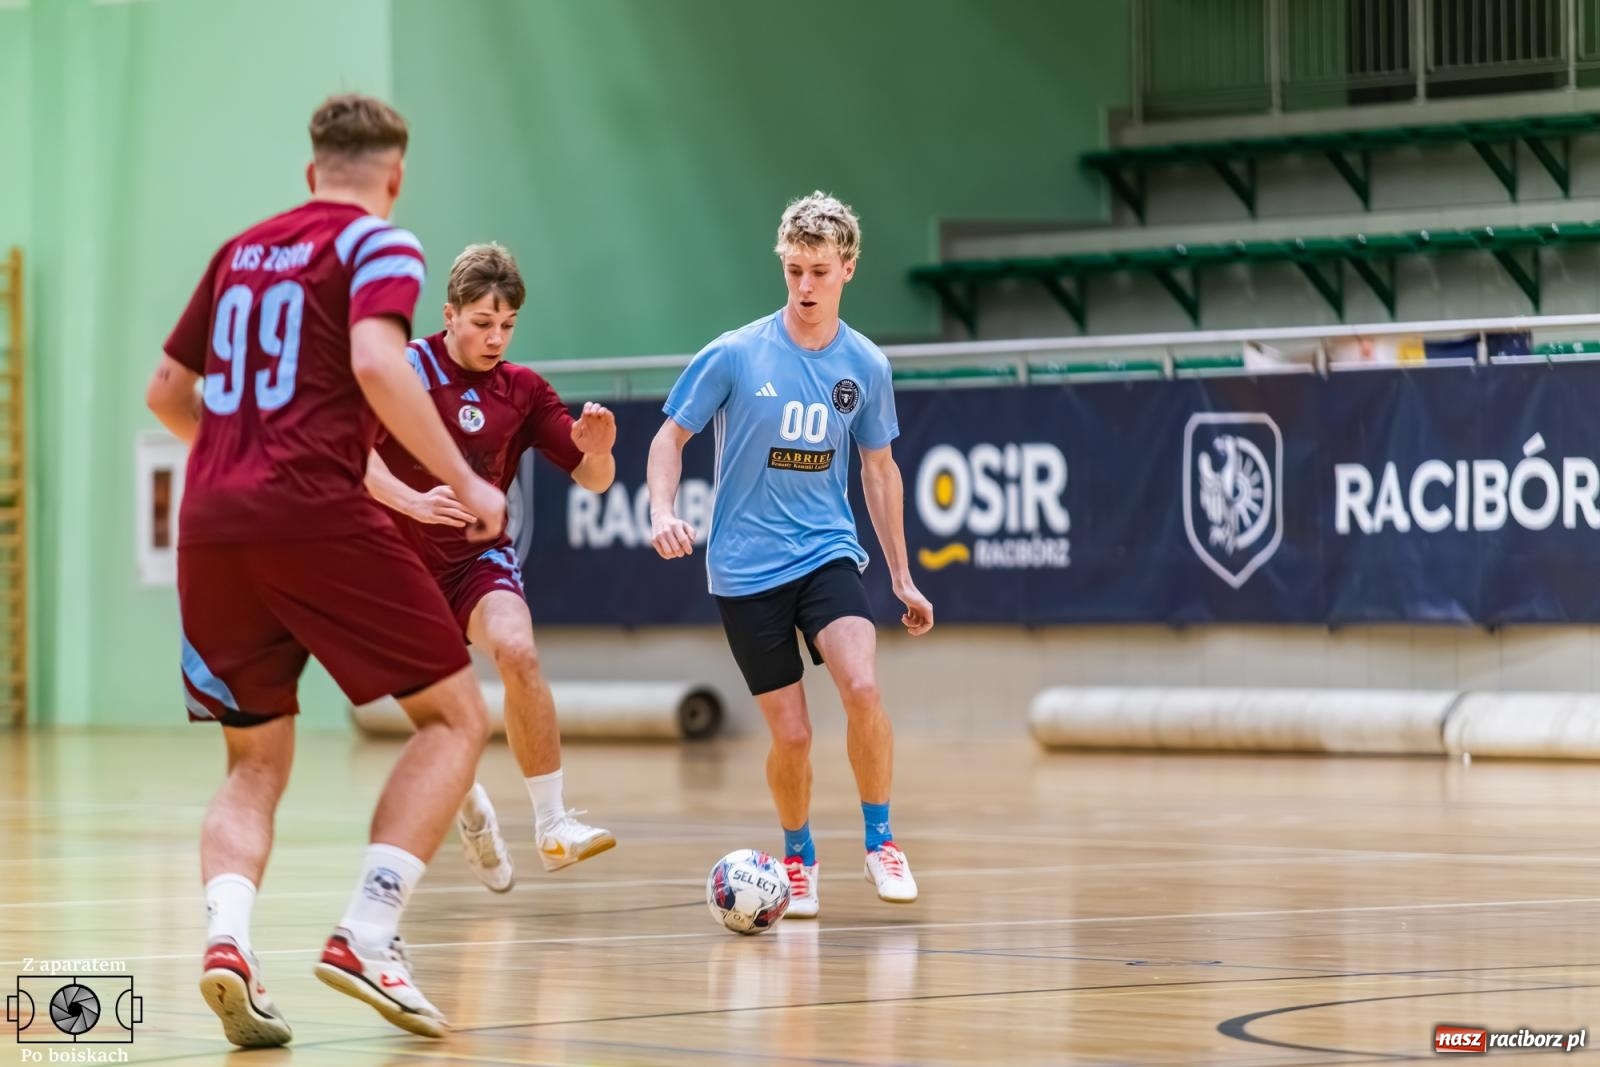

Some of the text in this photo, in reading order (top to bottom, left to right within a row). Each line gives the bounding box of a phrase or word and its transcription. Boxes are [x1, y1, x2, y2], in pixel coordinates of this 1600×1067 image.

[204, 279, 304, 416] 99
[780, 400, 829, 444] 00
[772, 451, 832, 463] GABRIEL
[733, 870, 777, 895] SELECT
